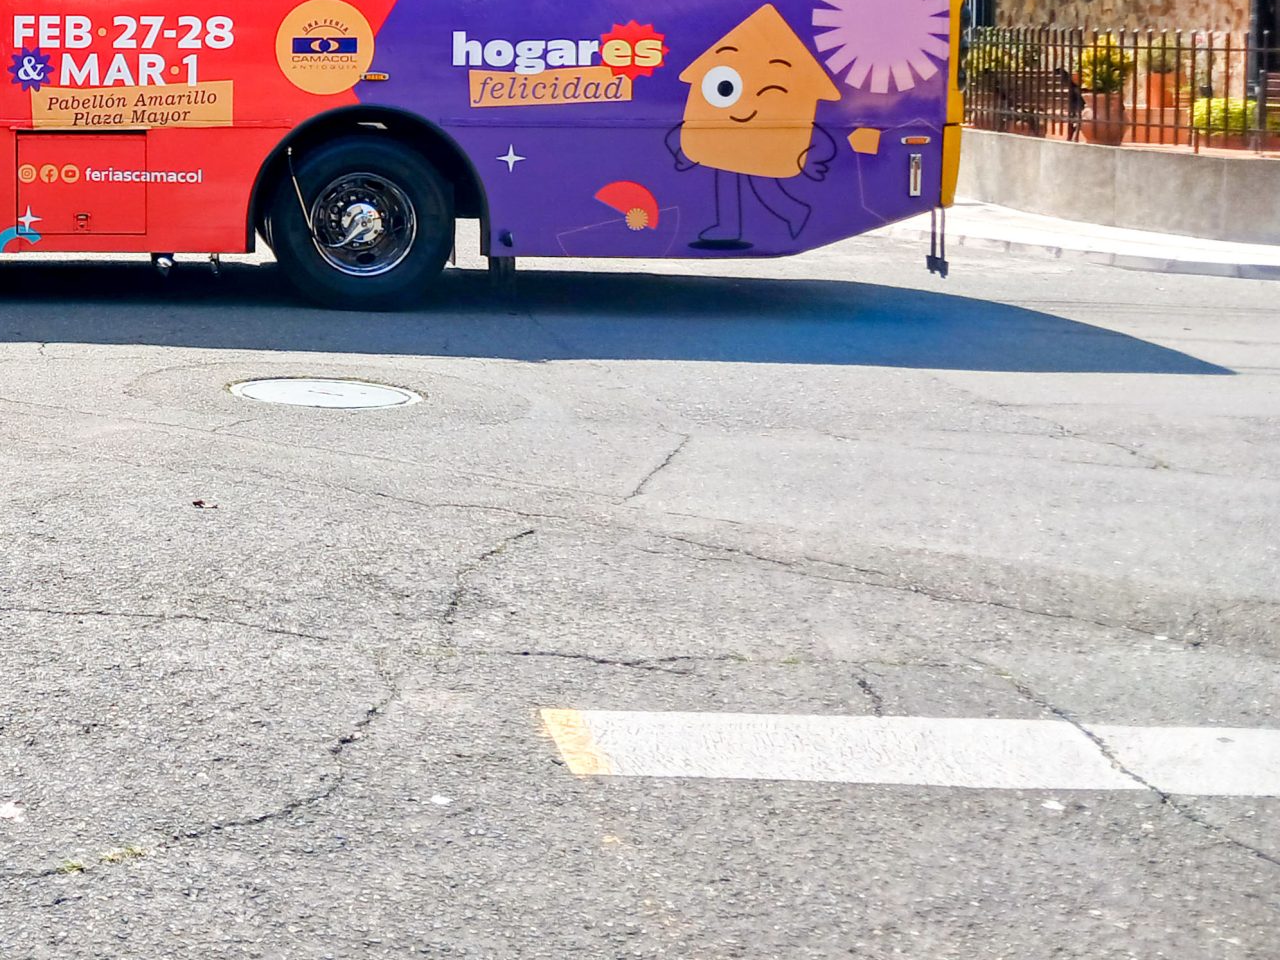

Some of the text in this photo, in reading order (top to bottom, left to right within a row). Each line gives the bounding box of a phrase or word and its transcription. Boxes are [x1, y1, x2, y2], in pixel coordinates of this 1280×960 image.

[302, 19, 349, 33] UNA FERIA
[291, 55, 357, 63] CAMACOL
[452, 31, 663, 75] hogares
[473, 76, 624, 104] felicidad
[47, 90, 218, 111] Pabellón Amarillo
[72, 109, 191, 126] Plaza Mayor
[84, 167, 203, 183] feriascamacol
